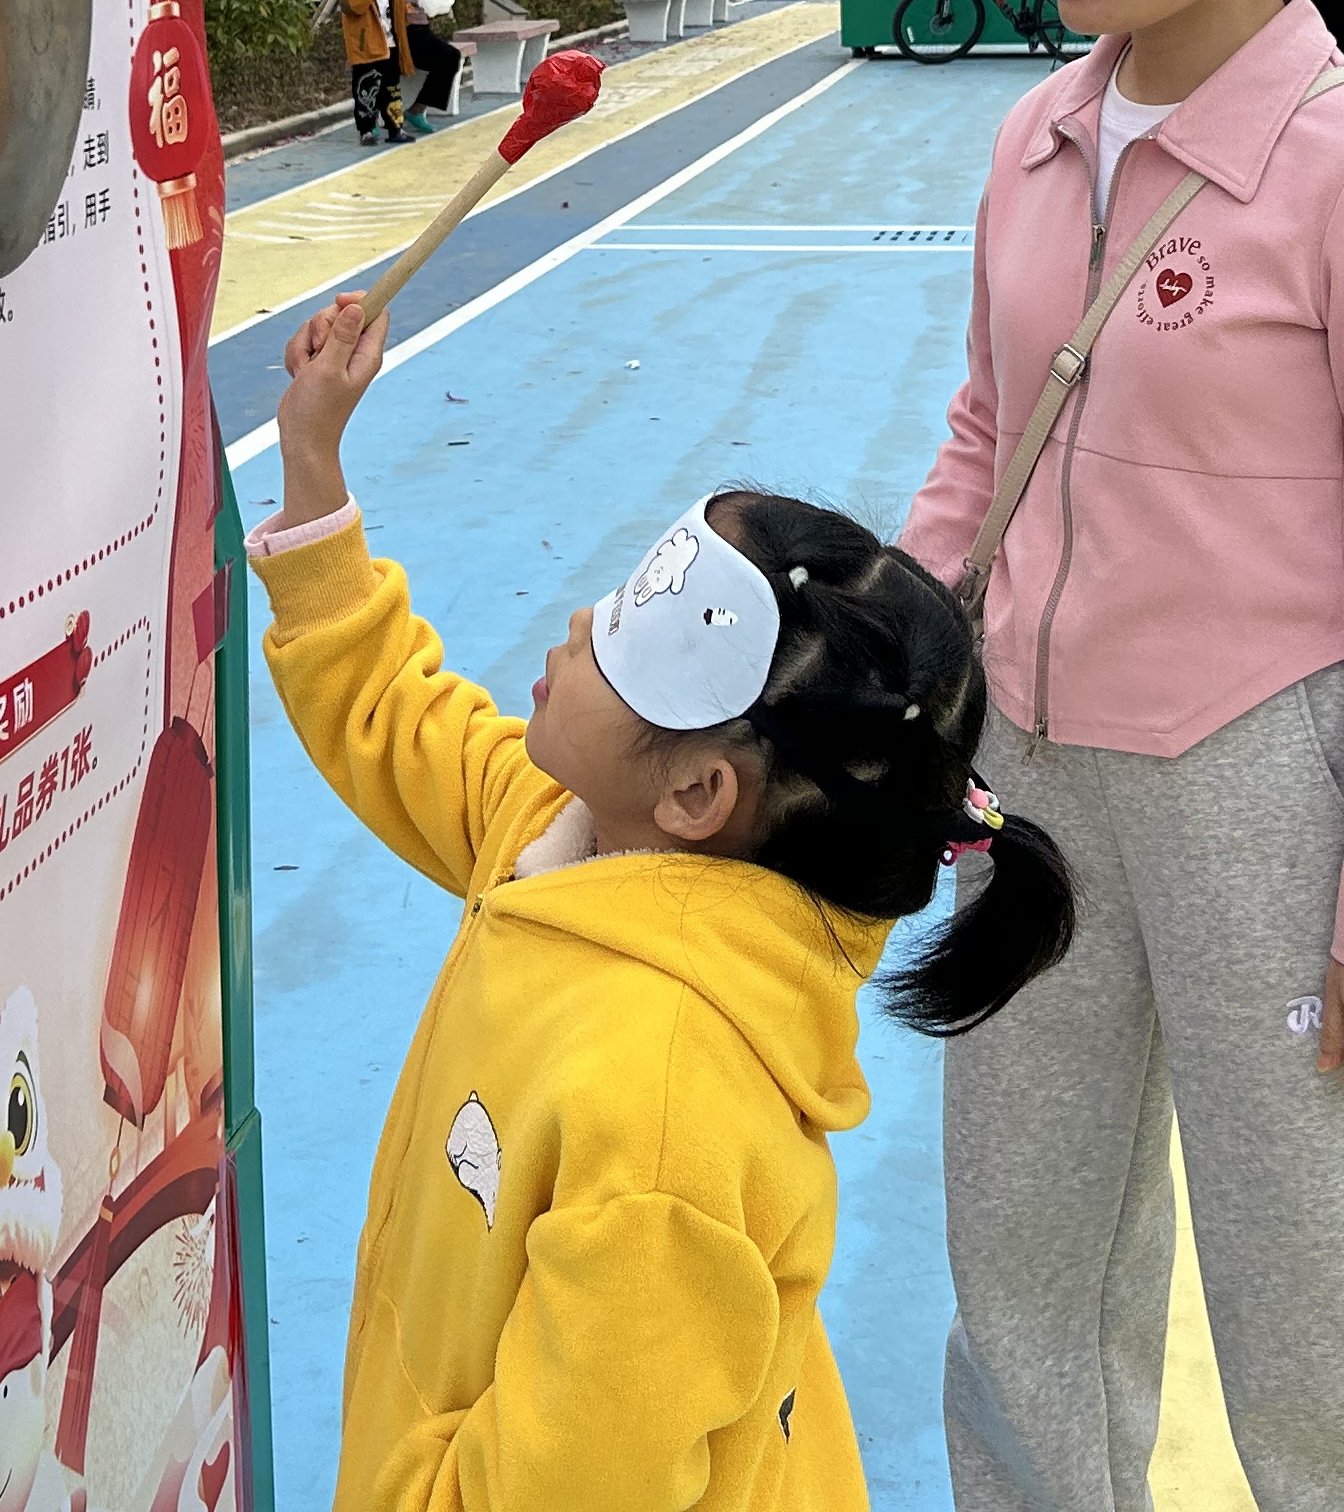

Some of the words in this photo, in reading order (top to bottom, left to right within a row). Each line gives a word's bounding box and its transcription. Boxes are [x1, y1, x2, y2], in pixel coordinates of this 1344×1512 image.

[148, 47, 189, 149] 福
[1145, 237, 1201, 272] Brave
[1196, 255, 1210, 271] so
[1195, 275, 1215, 315] make
[1156, 311, 1193, 332] great
